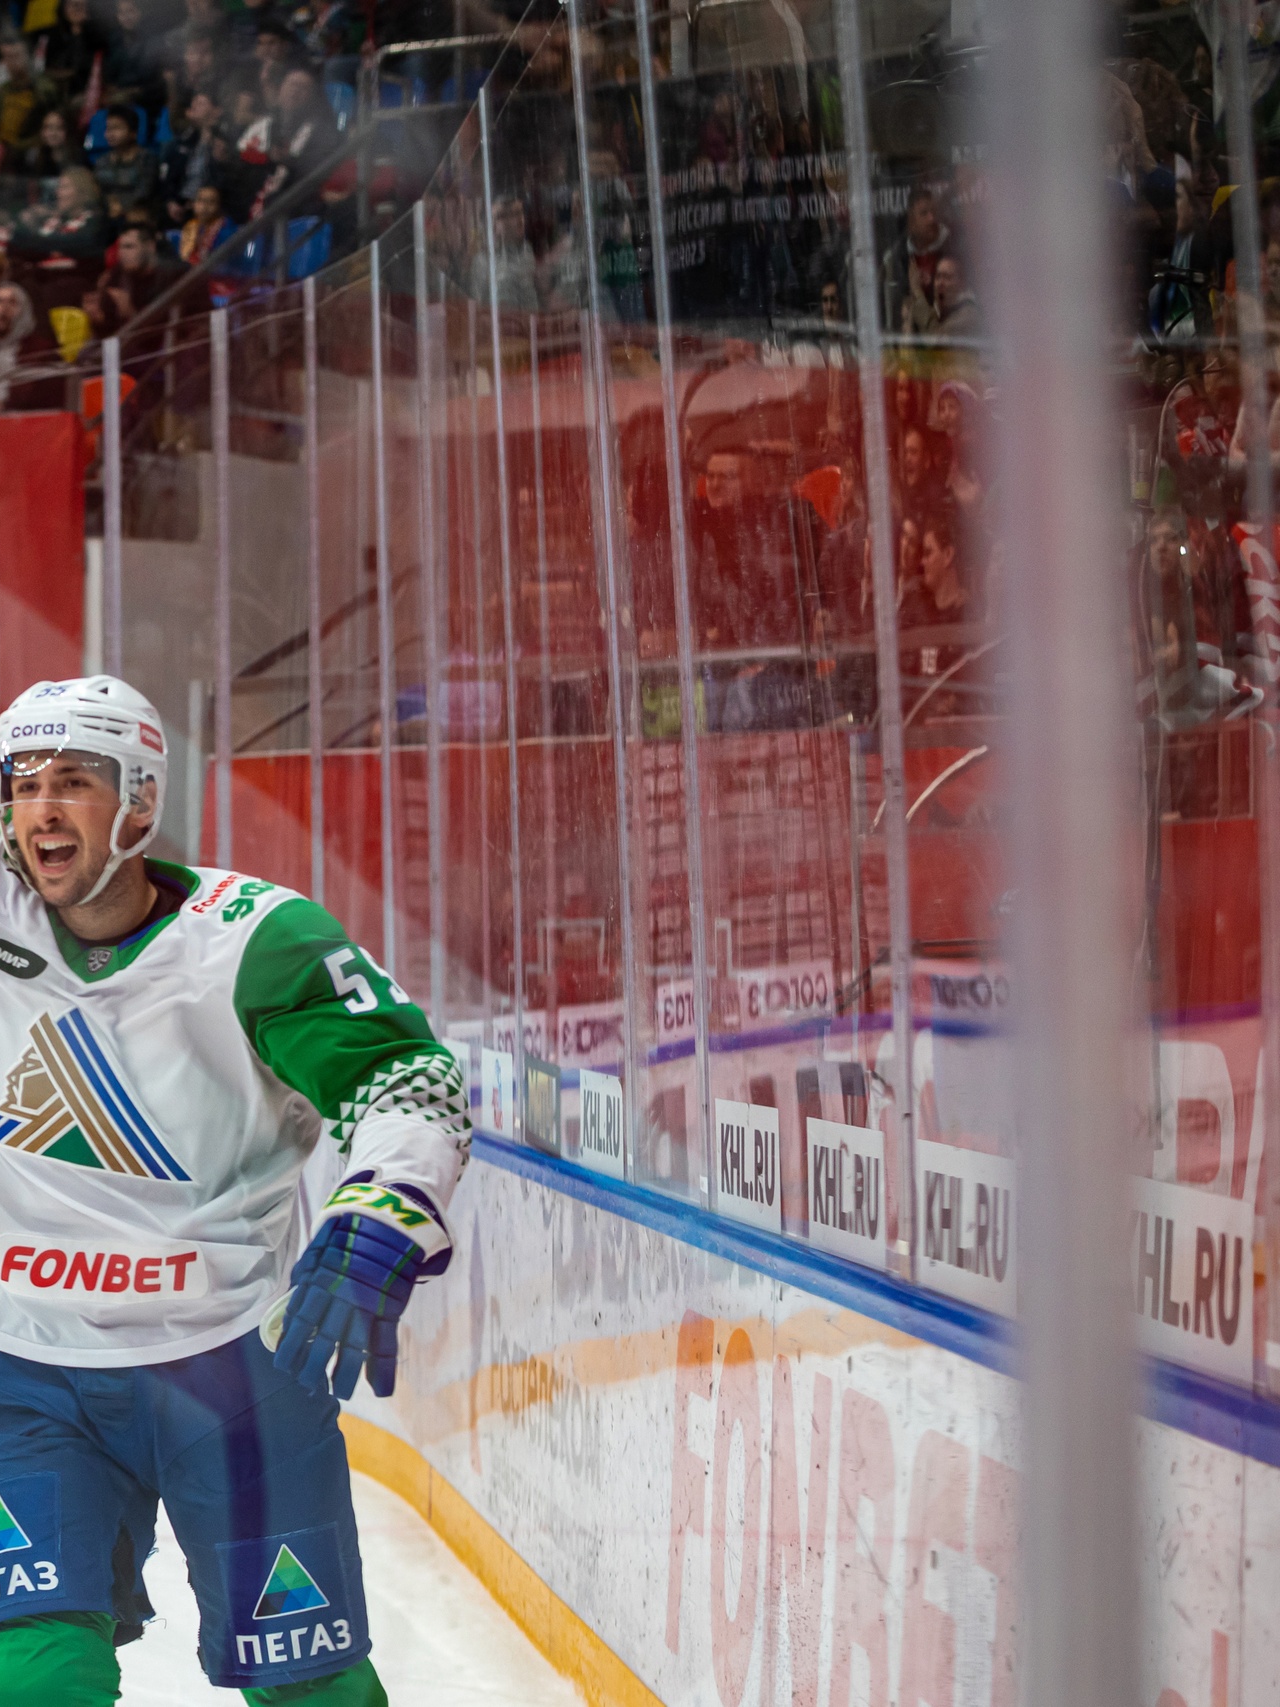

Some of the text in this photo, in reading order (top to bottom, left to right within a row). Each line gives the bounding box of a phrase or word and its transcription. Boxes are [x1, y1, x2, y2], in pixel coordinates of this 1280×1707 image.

[191, 872, 250, 914] FONBE
[583, 1089, 621, 1159] KHL.RU
[720, 1122, 776, 1207] KHL.RU
[812, 1143, 880, 1241] KHL.RU
[923, 1169, 1011, 1283] KHL.RU
[1, 1244, 200, 1294] FONBET
[235, 1618, 353, 1665] ПЕГАЗ
